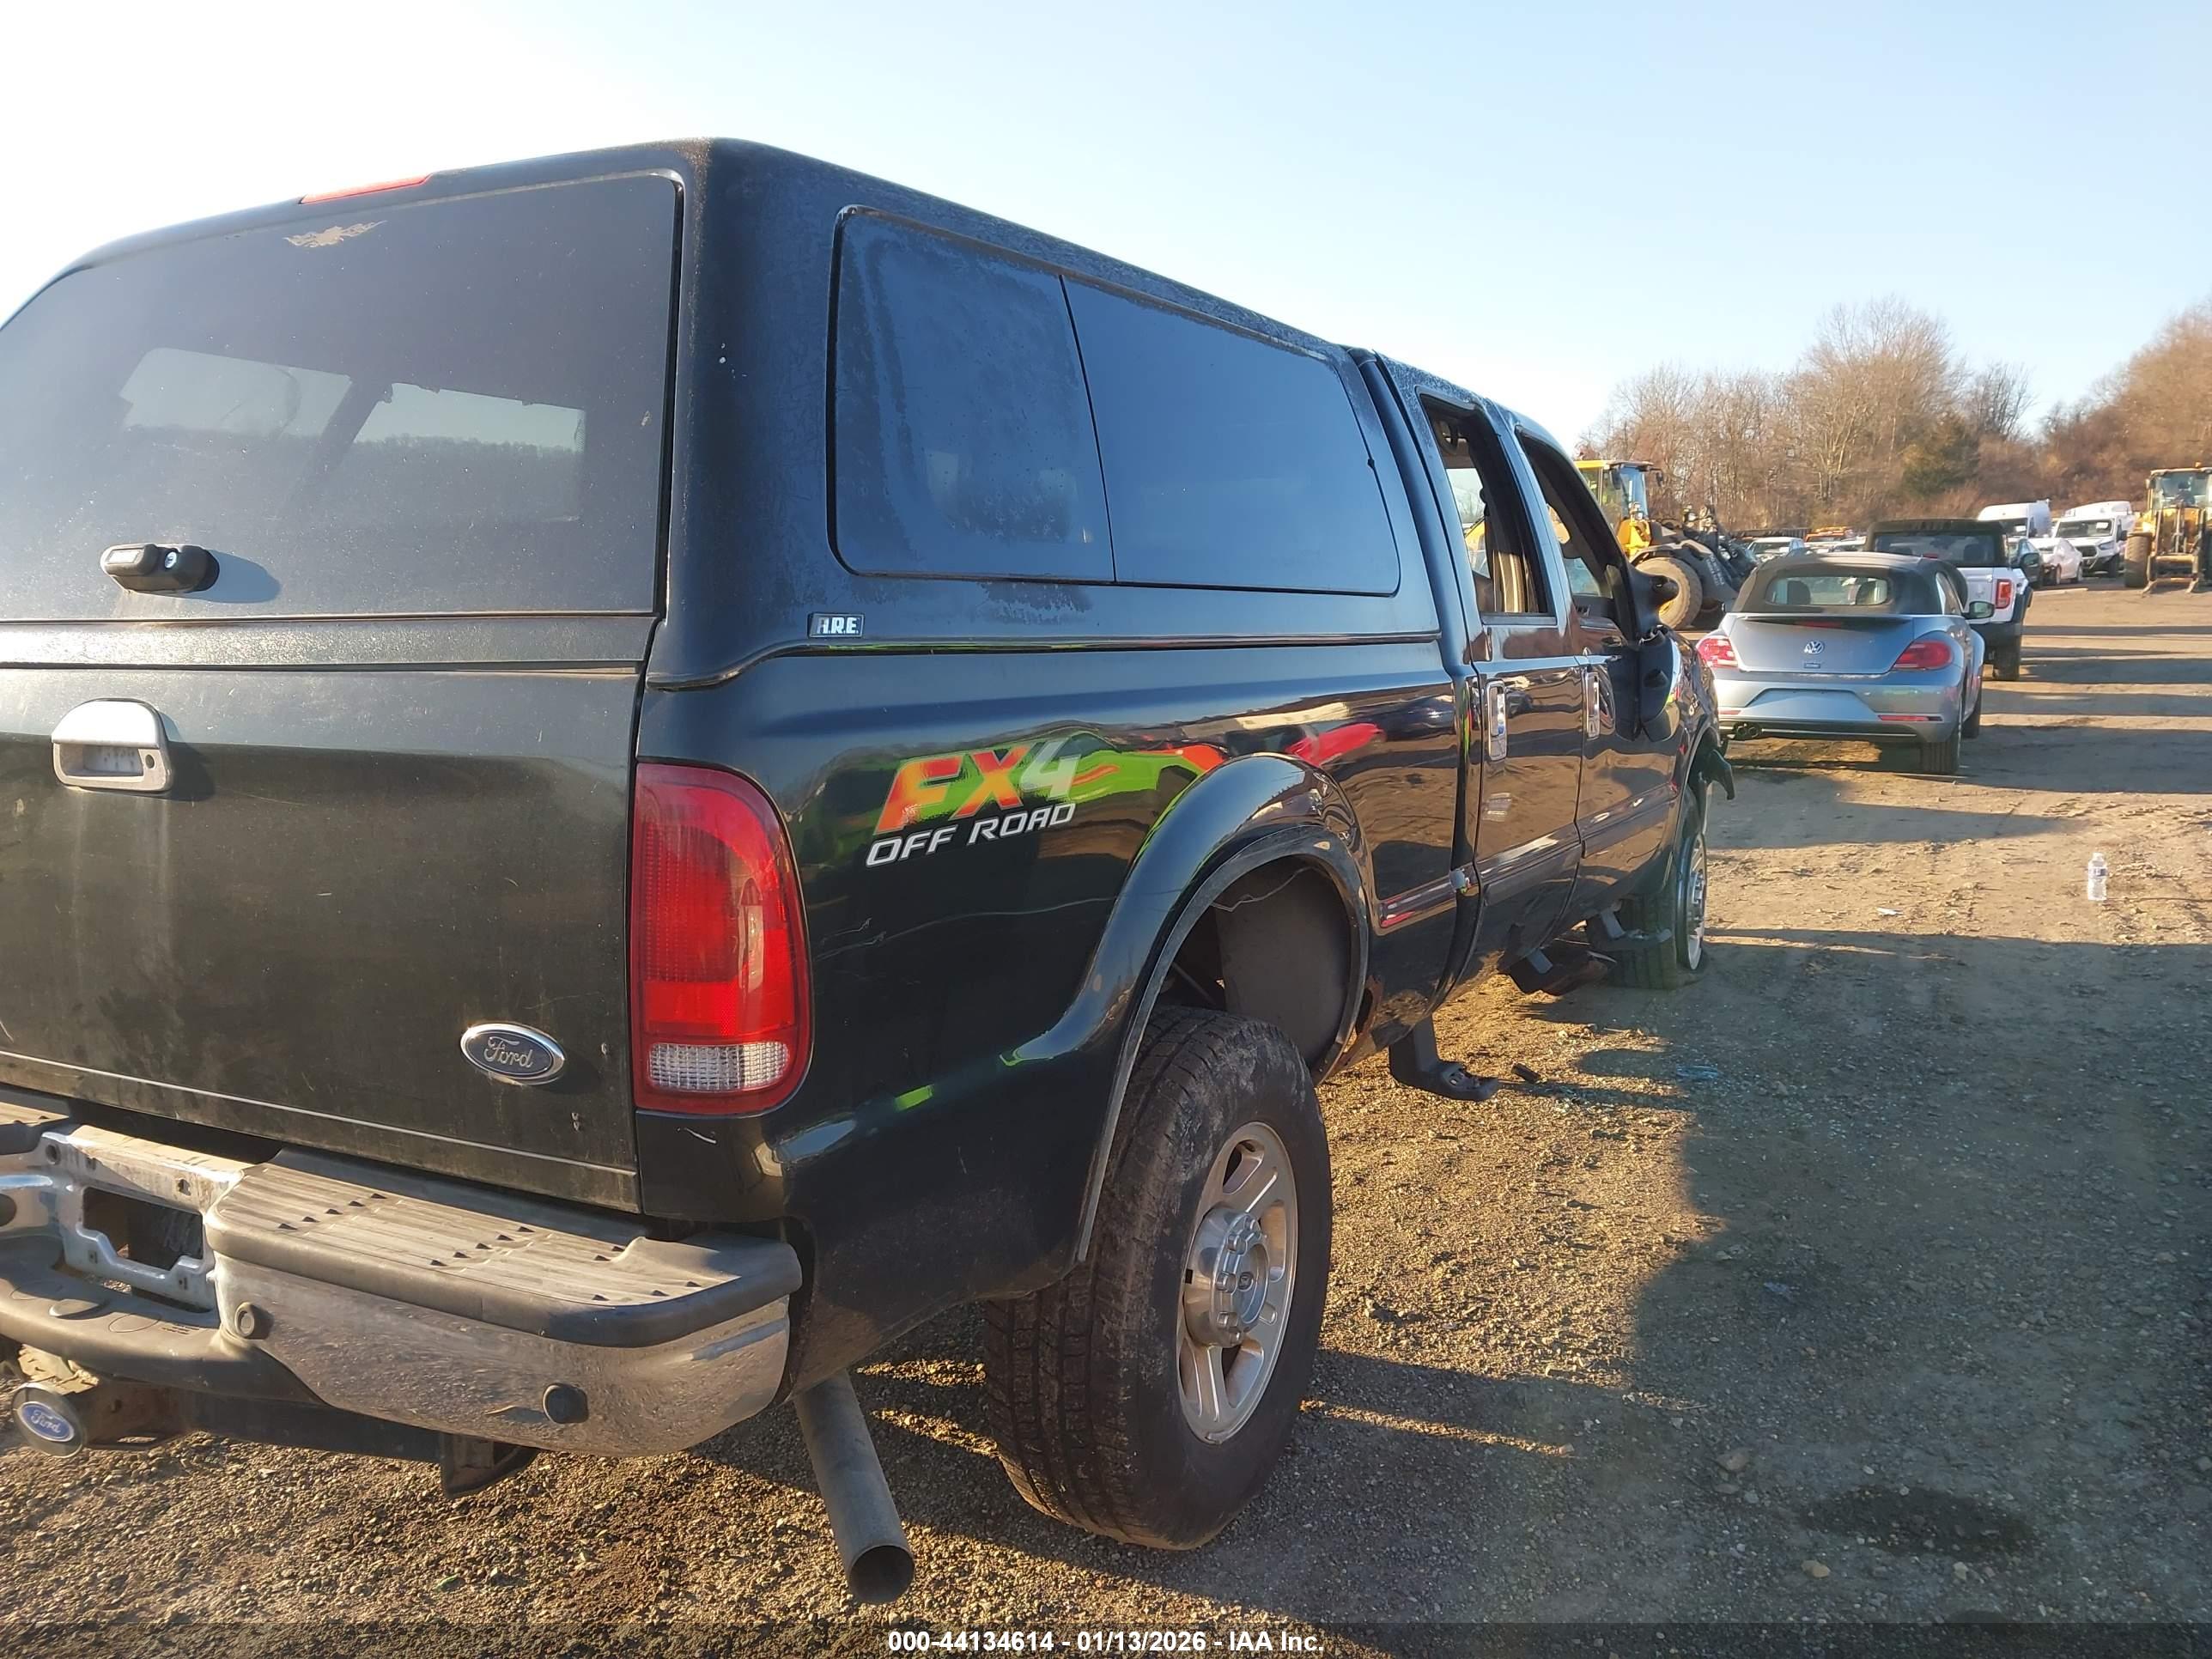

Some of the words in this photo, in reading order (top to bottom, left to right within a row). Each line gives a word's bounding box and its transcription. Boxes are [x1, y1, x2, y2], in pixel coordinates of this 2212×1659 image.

[873, 736, 1082, 836] FX4
[866, 824, 958, 867] OFF
[967, 802, 1076, 846] ROAD
[483, 1036, 534, 1068] Ford
[31, 1409, 62, 1433] Ford
